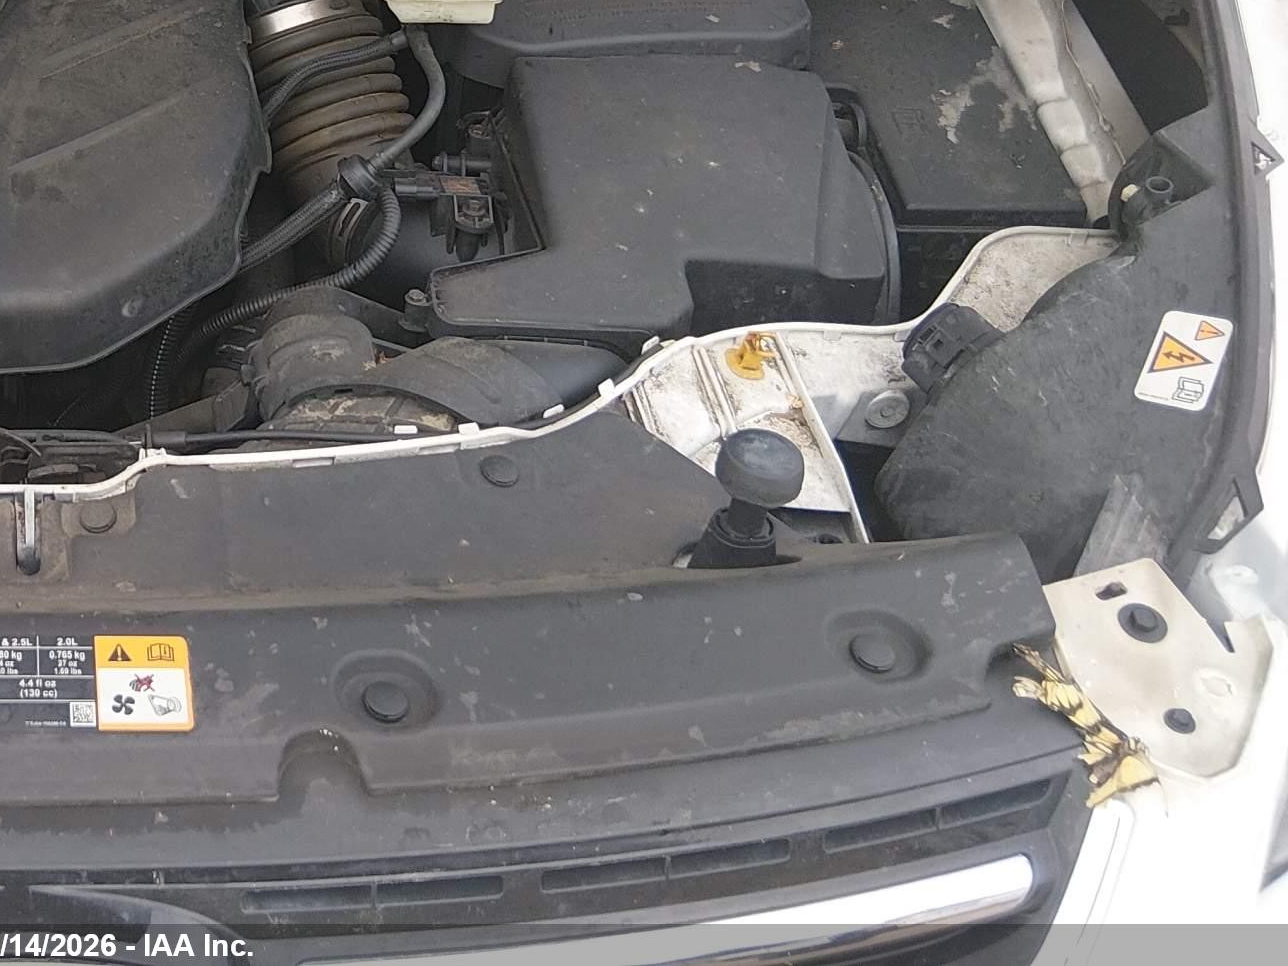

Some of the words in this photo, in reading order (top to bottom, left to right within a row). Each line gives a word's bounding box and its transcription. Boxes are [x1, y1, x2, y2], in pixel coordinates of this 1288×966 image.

[1, 637, 10, 646] &
[11, 637, 33, 646] 2.5L
[56, 637, 79, 646] 2.0L
[11, 649, 23, 662] kg
[48, 649, 73, 660] 0.765
[74, 649, 86, 662] kg
[18, 679, 34, 688] 4.4
[35, 679, 43, 688] fl
[44, 680, 57, 688] oz
[19, 689, 41, 699] (130
[42, 689, 58, 699] cc)
